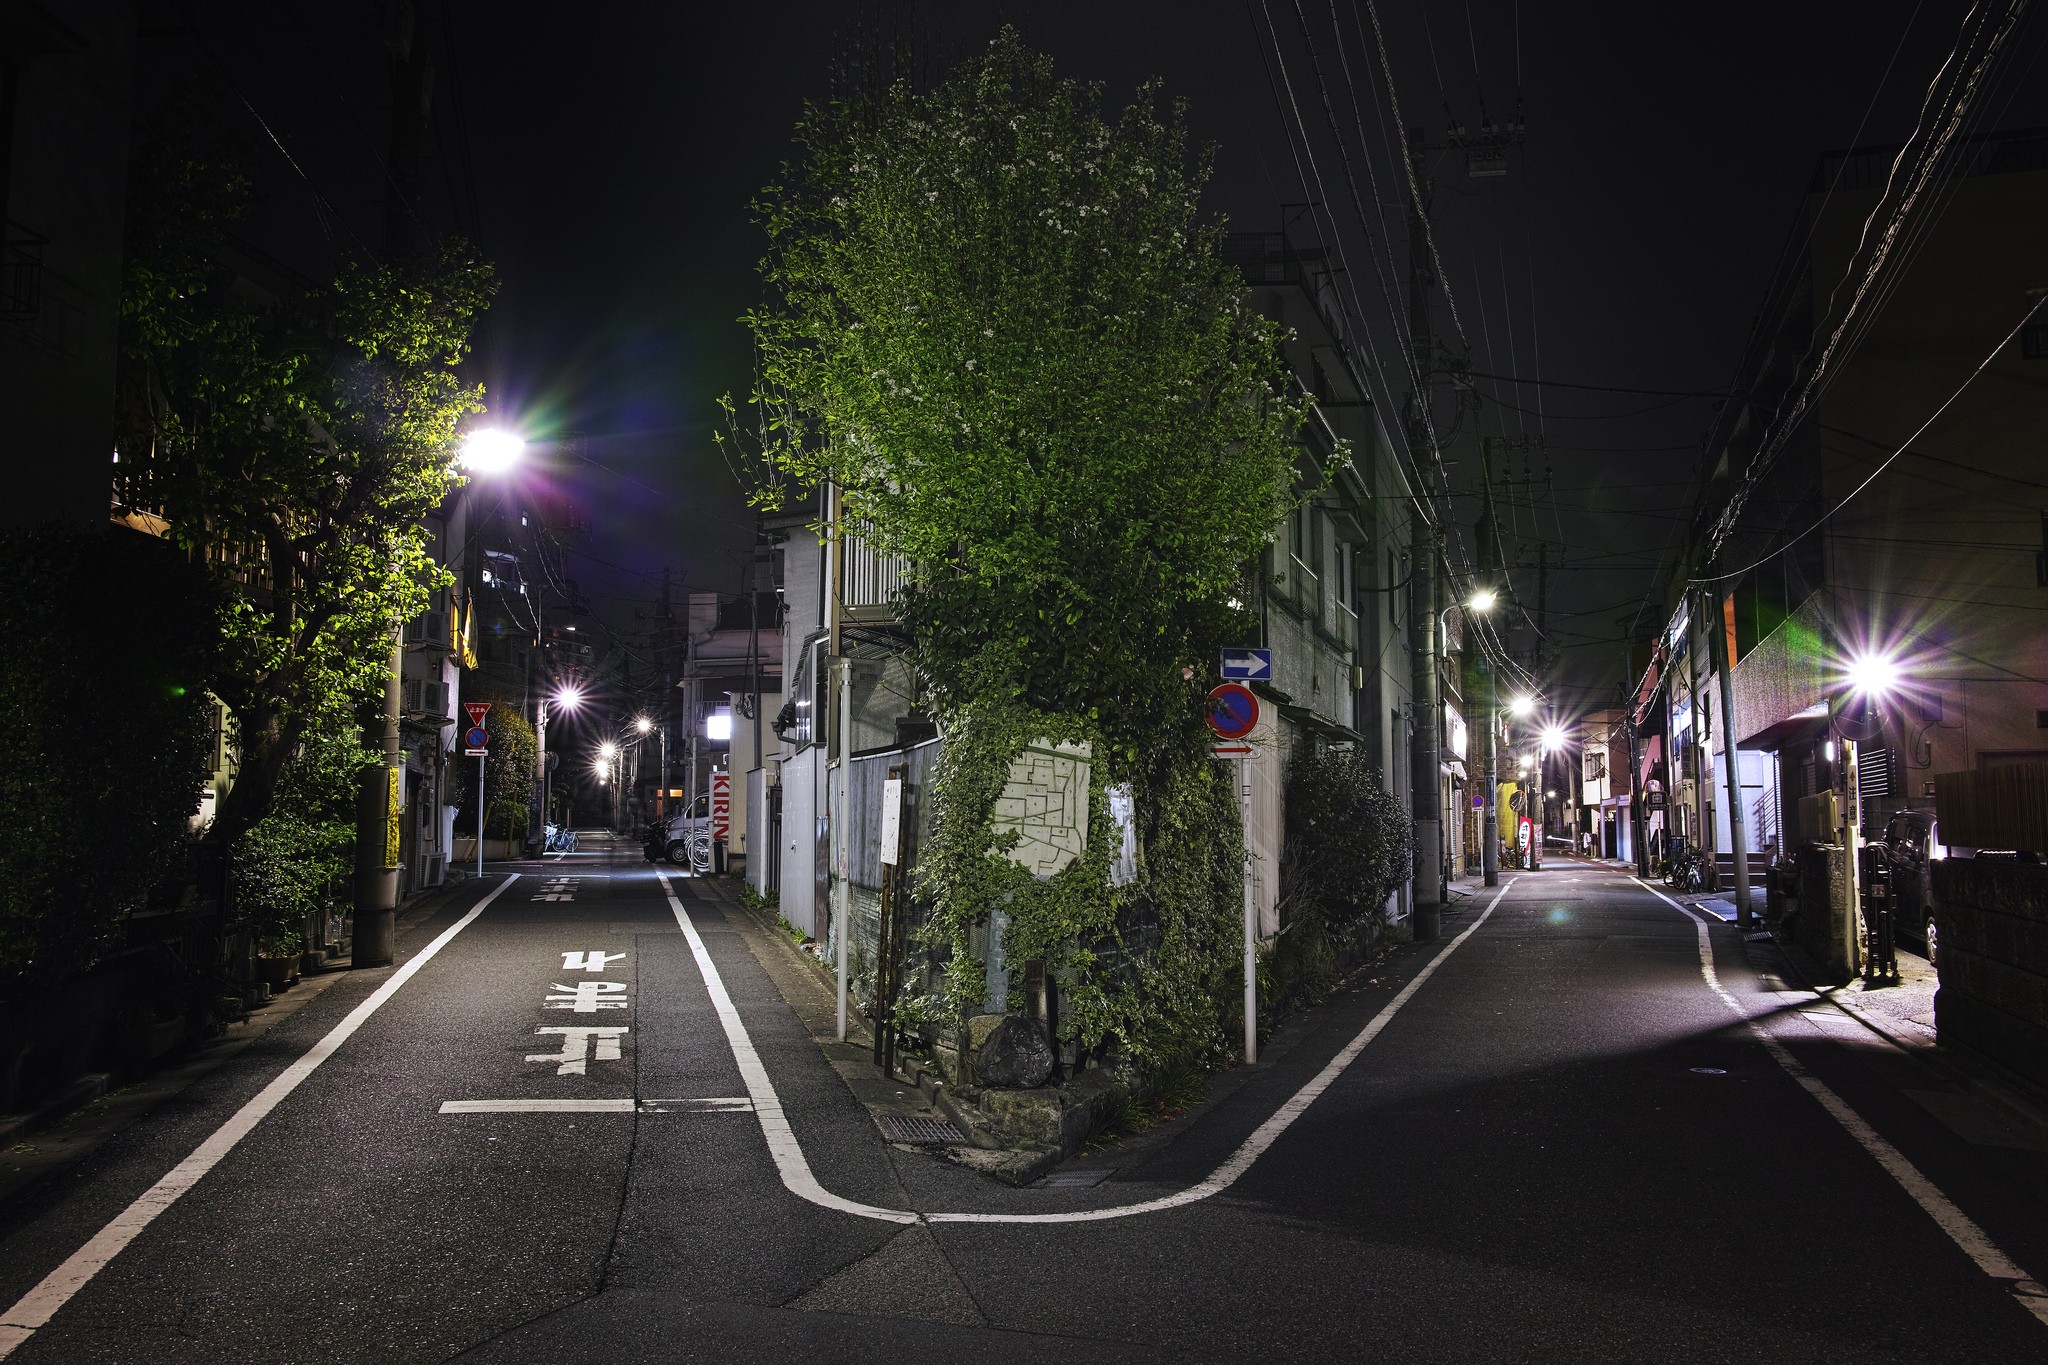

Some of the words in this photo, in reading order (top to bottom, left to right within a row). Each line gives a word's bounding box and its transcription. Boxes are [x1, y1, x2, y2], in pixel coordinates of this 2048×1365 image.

[713, 775, 730, 841] KIRIN
[1848, 785, 1857, 821] 注意
[524, 950, 630, 1076] 止まれ
